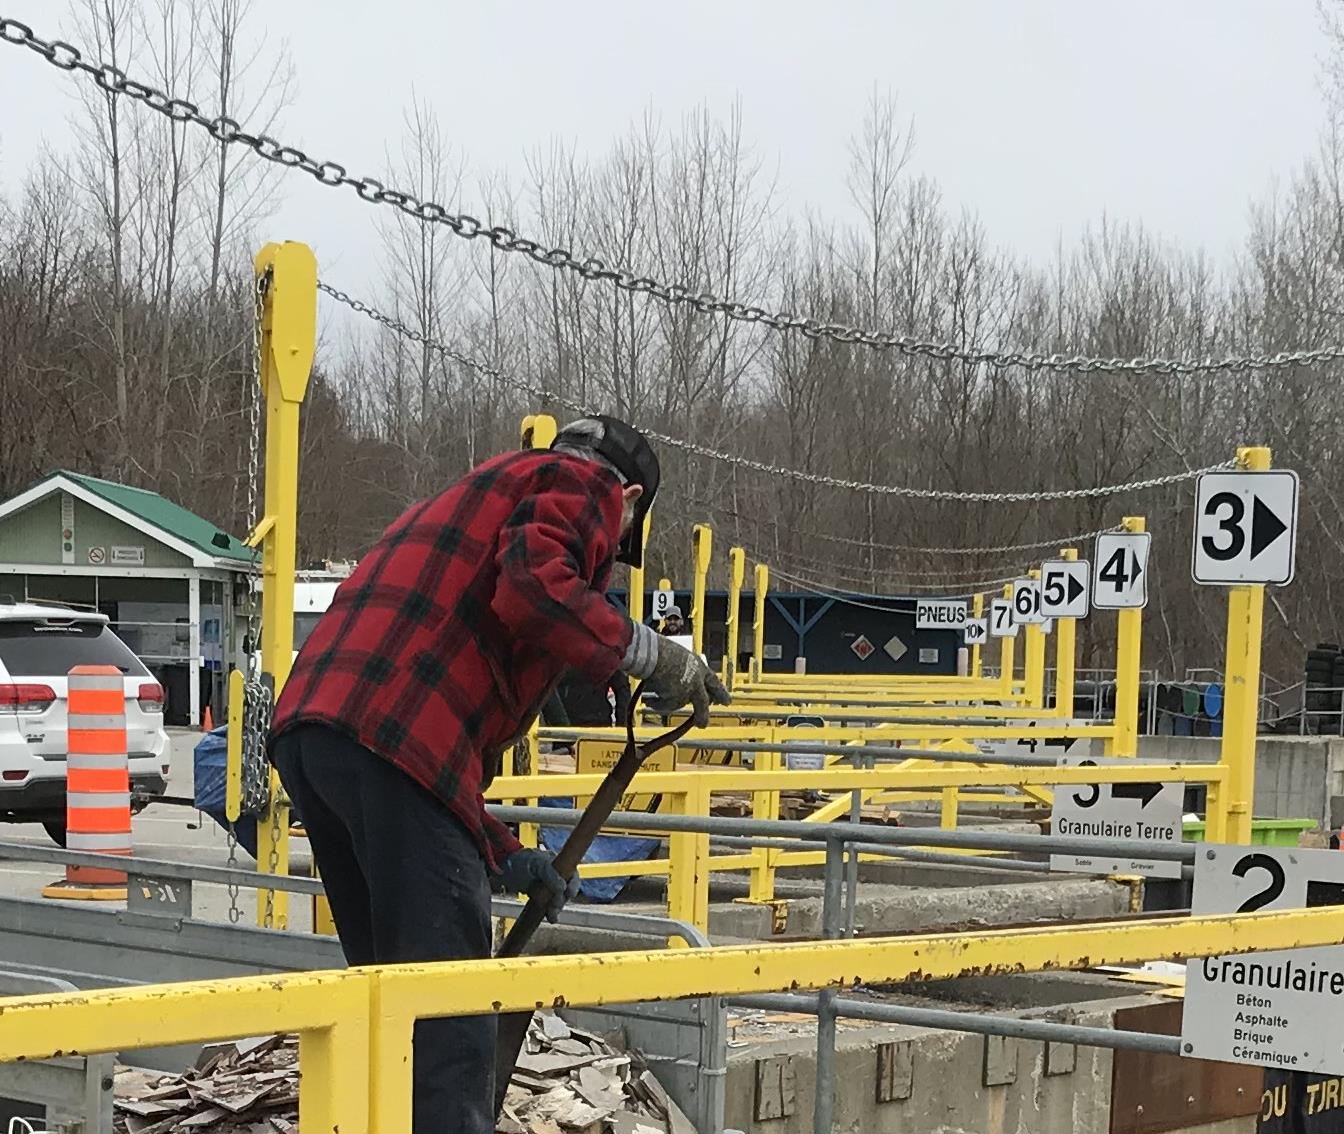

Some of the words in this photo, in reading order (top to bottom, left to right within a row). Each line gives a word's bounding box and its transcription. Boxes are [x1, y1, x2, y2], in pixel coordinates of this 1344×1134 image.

[1200, 491, 1246, 561] 3
[1098, 547, 1129, 593] 4
[657, 592, 668, 608] 9
[1015, 586, 1032, 615] 6
[1043, 571, 1066, 606] 5
[917, 605, 966, 624] PNEUS
[993, 605, 1007, 629] 7
[966, 624, 977, 638] 10
[1058, 817, 1132, 839] Granulaire
[1136, 821, 1174, 841] Terre
[1230, 853, 1286, 914] 2
[1202, 957, 1344, 996] Granulaire
[1235, 993, 1272, 1008] Béton
[1234, 1012, 1288, 1029] Asphalte
[1233, 1029, 1274, 1045] Brique
[1232, 1046, 1298, 1066] Céramique
